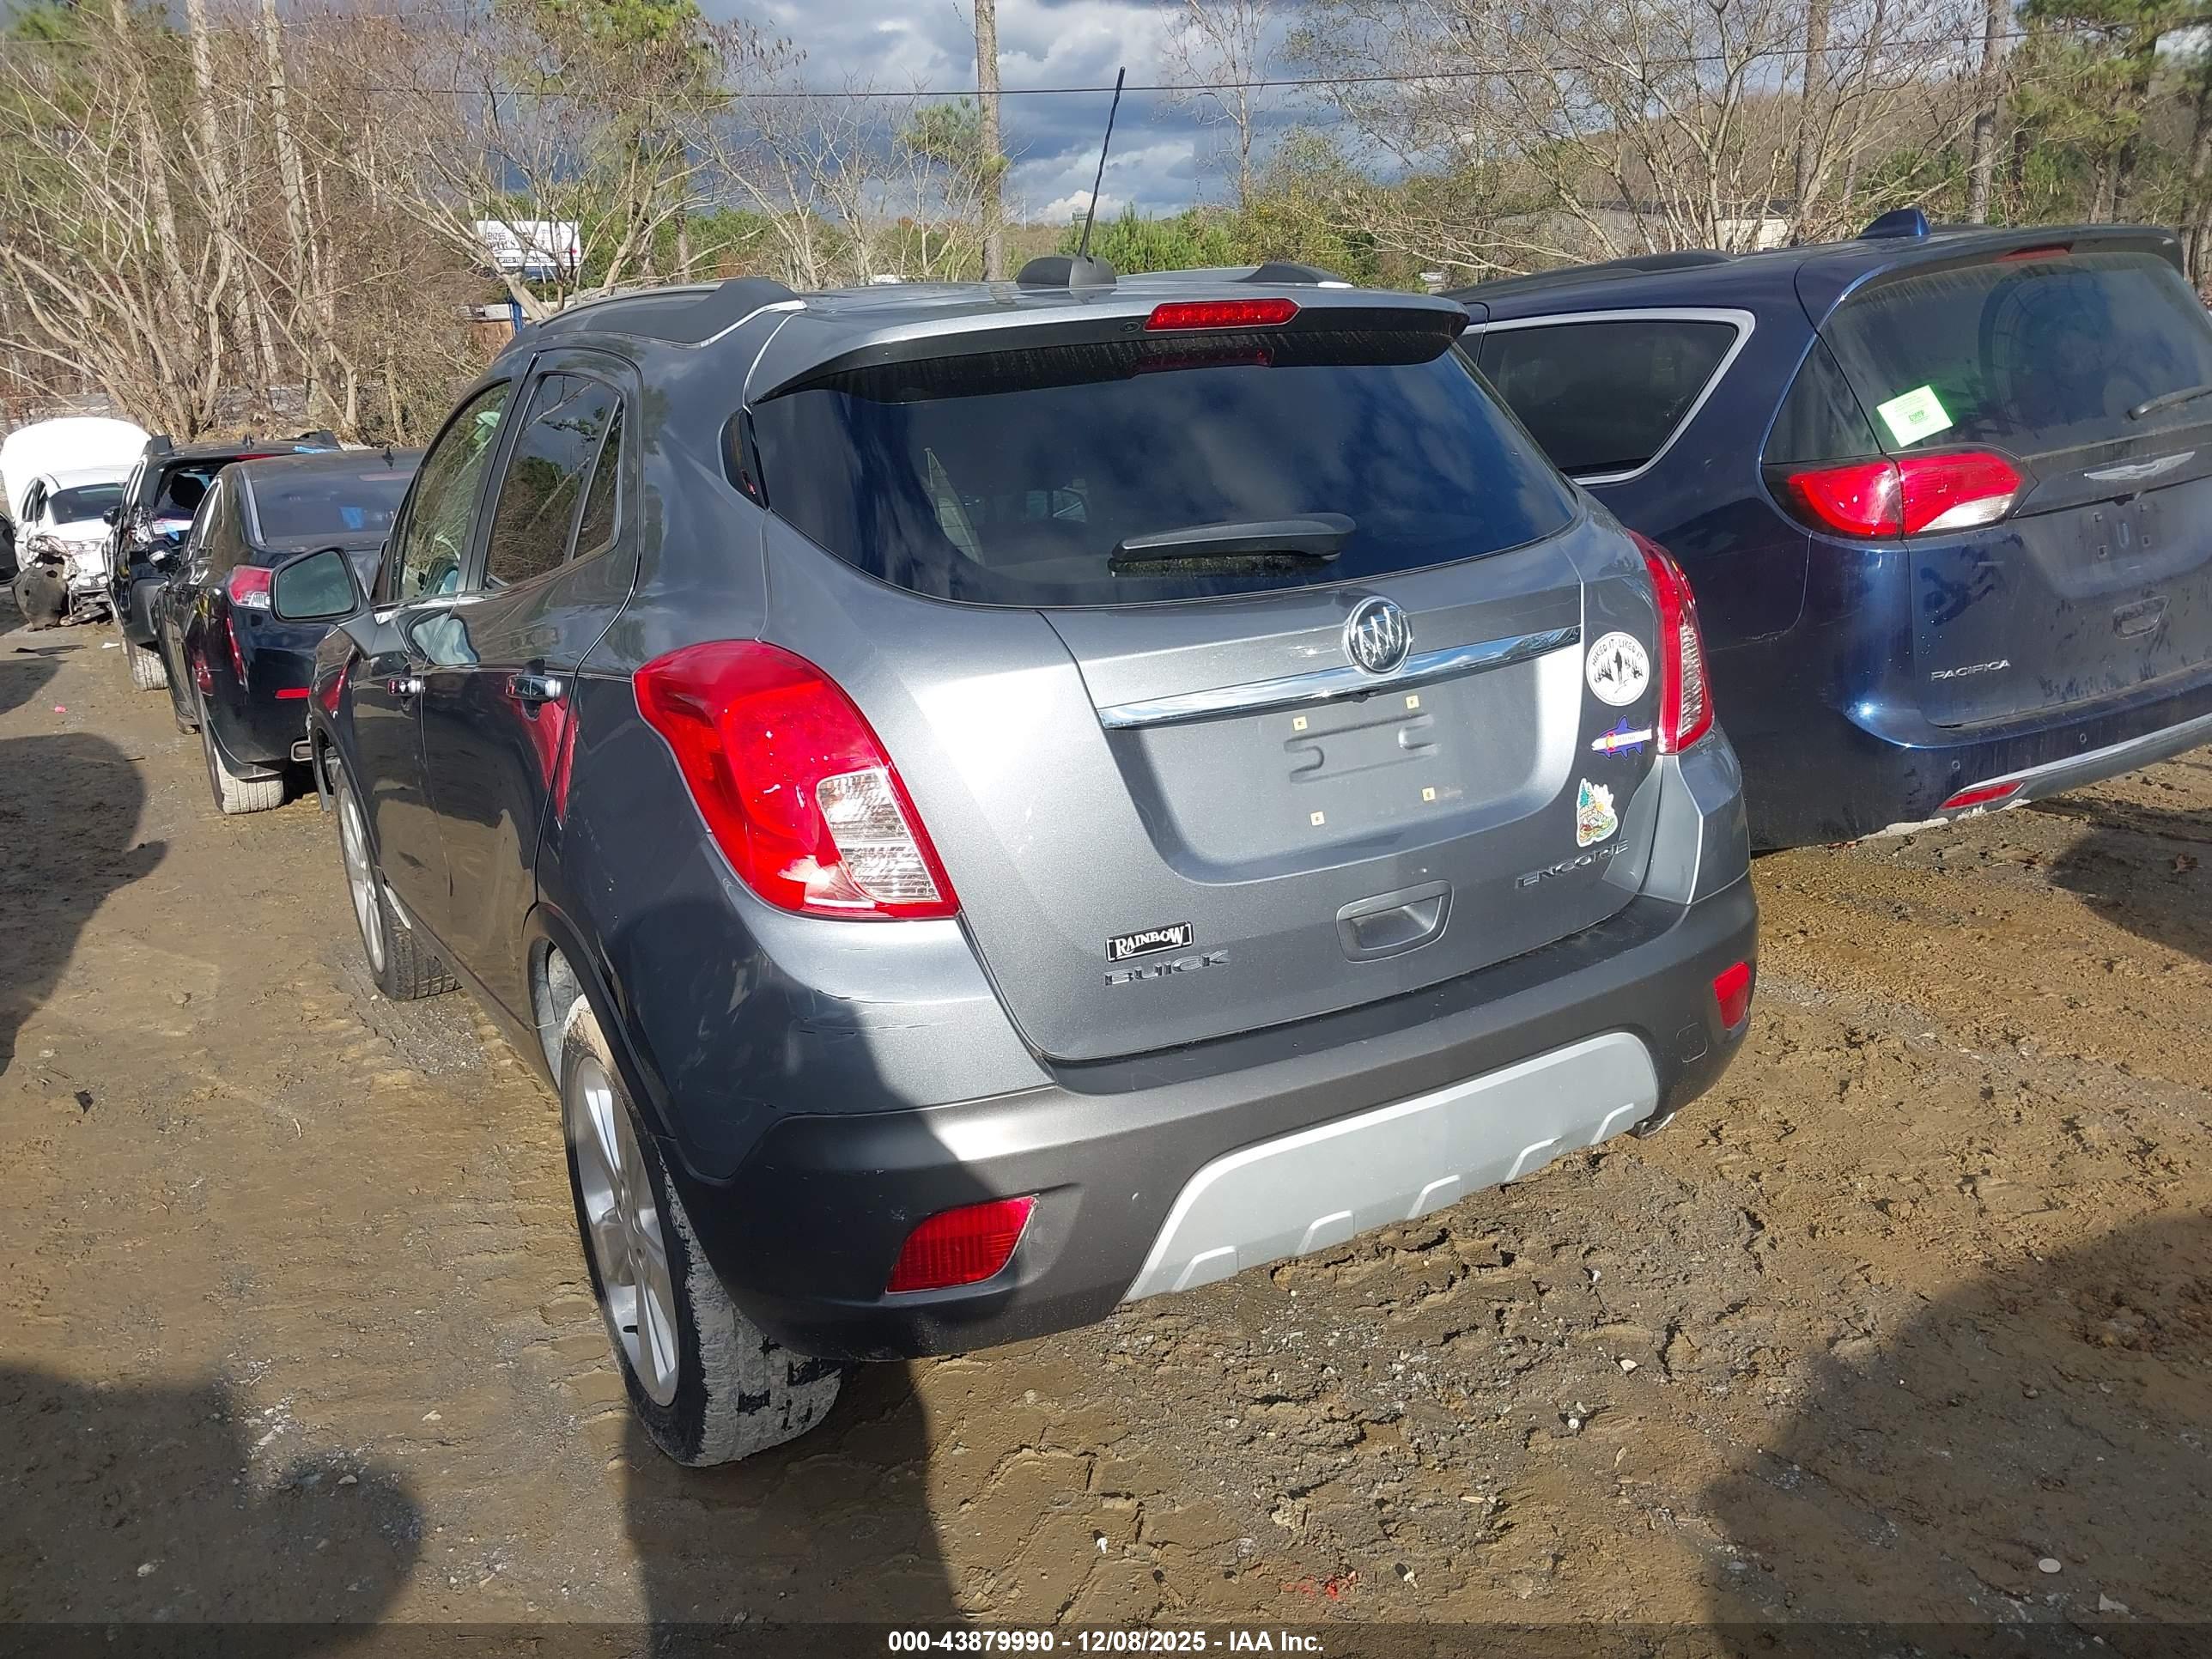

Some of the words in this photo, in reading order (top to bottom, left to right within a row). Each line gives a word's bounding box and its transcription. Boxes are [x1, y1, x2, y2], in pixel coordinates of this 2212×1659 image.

[1930, 659, 2011, 682] PACIFICA
[1516, 839, 1629, 888] ENCORE
[1115, 925, 1185, 957] RAINBOW
[1104, 948, 1231, 987] BUICK
